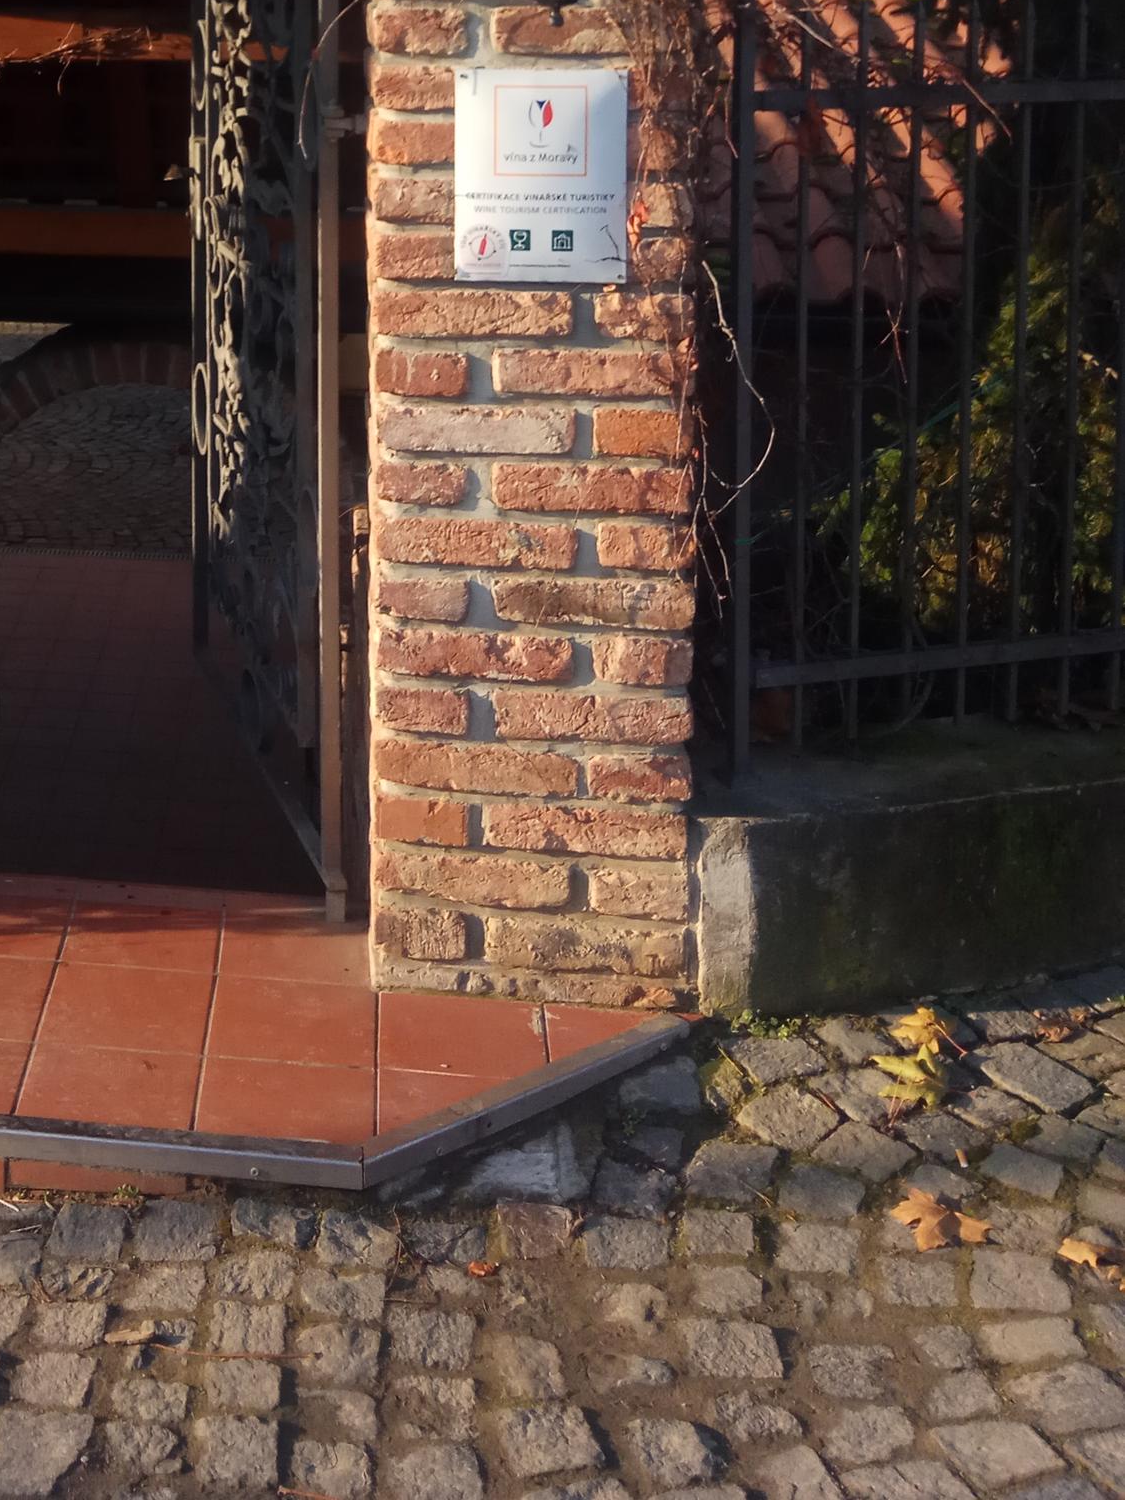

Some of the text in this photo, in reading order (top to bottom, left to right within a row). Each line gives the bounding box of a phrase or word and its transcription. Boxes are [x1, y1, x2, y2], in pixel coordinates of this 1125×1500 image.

[503, 153, 579, 165] vína z Moravy
[465, 191, 616, 201] CERTIFIKACE VINAŘSKÉ TURISTIKY
[474, 205, 608, 215] WINE TOURISM CERTIFICATION
